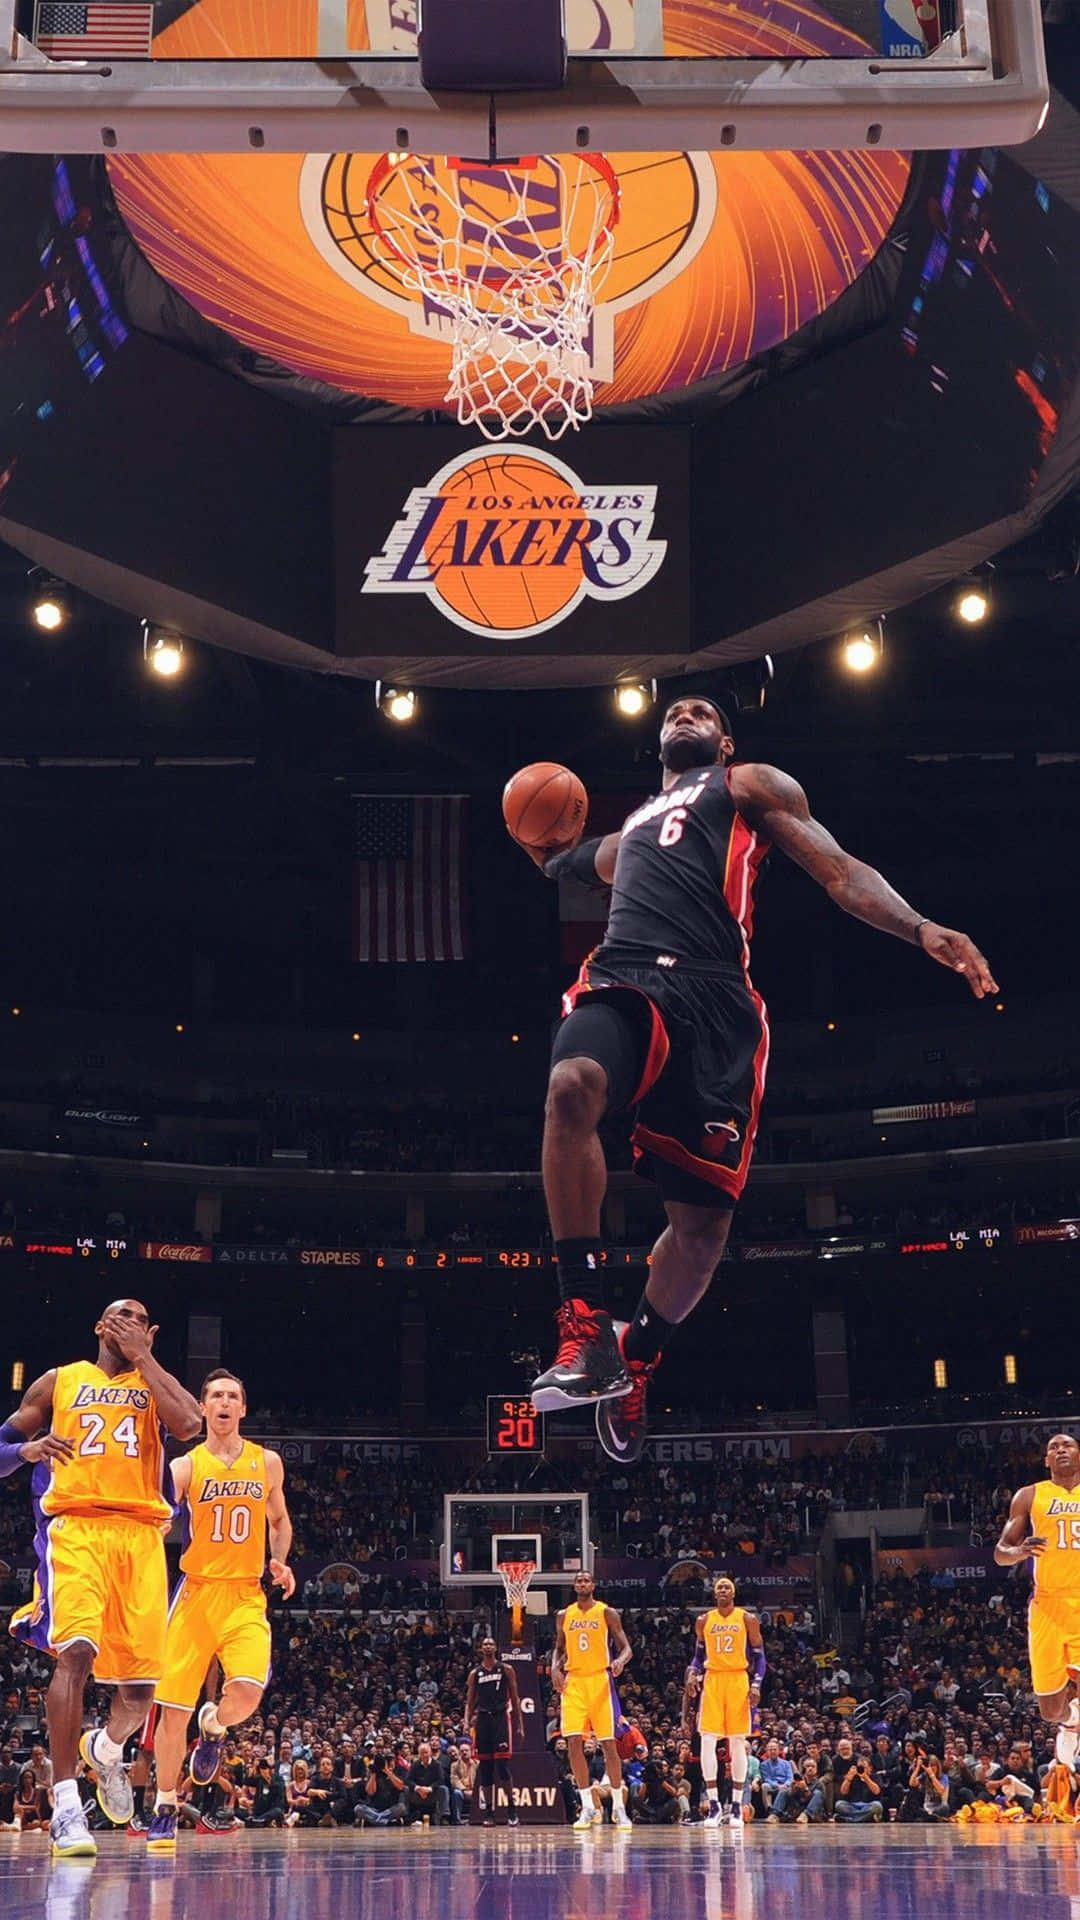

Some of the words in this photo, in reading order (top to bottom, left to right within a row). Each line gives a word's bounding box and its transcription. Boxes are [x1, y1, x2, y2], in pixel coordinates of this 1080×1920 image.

[466, 495, 513, 510] LOS
[520, 494, 645, 510] ANGELES
[378, 496, 655, 589] LAKERS
[658, 808, 688, 846] 6
[950, 1232, 970, 1241] LAL
[979, 1229, 1000, 1239] MIA
[77, 1238, 96, 1247] LAL
[106, 1240, 127, 1249] MIA
[821, 1244, 864, 1255] Panasonic
[955, 1241, 964, 1250] 0
[984, 1238, 993, 1247] 0
[81, 1247, 90, 1257] 0
[110, 1249, 119, 1259] 0
[236, 1250, 289, 1262] DELTA
[301, 1250, 361, 1265] STAPLES
[406, 1254, 414, 1266] 0
[436, 1252, 447, 1268] 2
[745, 1246, 811, 1260] Budweiser
[376, 1257, 384, 1268] 6
[72, 1385, 150, 1409] LAKERS
[503, 1401, 538, 1417] 9:23
[80, 1413, 139, 1457] 24
[498, 1418, 535, 1448] 20
[199, 1478, 264, 1503] LAKERS
[210, 1503, 252, 1543] 10
[1056, 1519, 1080, 1550] 15
[944, 1566, 987, 1578] KERS
[578, 1631, 590, 1651] 6
[716, 1635, 735, 1653] 12
[497, 1786, 532, 1807] NBA
[533, 1786, 557, 1807] TV
